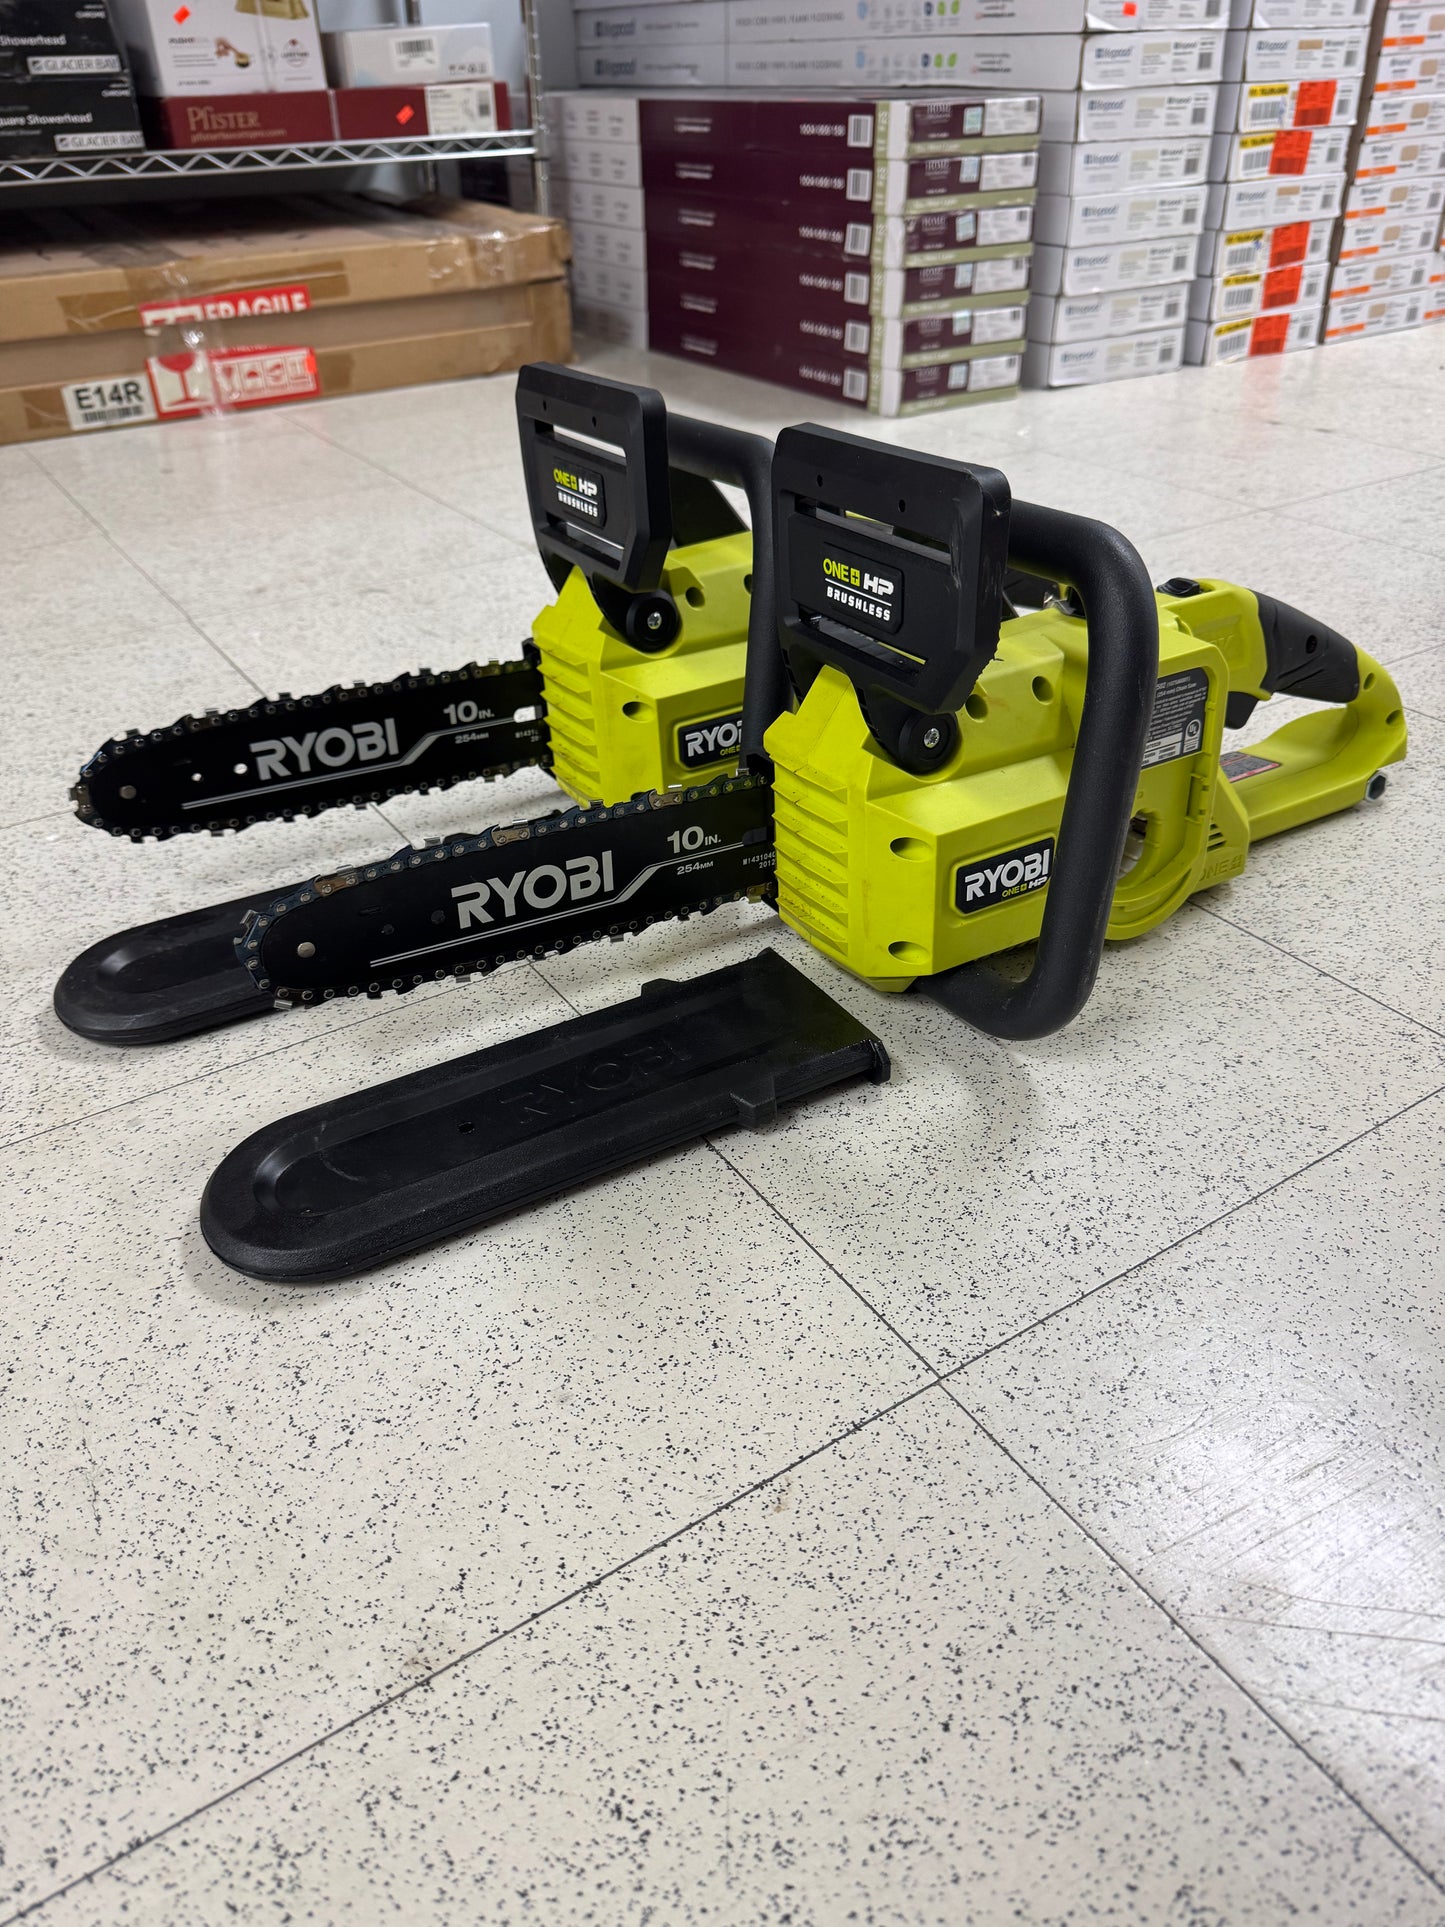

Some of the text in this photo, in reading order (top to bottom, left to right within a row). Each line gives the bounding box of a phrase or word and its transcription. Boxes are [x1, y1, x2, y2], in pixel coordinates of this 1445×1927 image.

[75, 381, 144, 411] E14R
[578, 478, 598, 497] HP
[557, 491, 598, 518] BRUSHLESS
[863, 572, 894, 596] HP
[826, 586, 891, 621] BRUSHLESS
[250, 718, 399, 781] RYOBI
[685, 720, 743, 757] RYO
[451, 850, 615, 929] RYOBI
[965, 848, 1050, 902] RYOBI
[1028, 876, 1048, 889] HP
